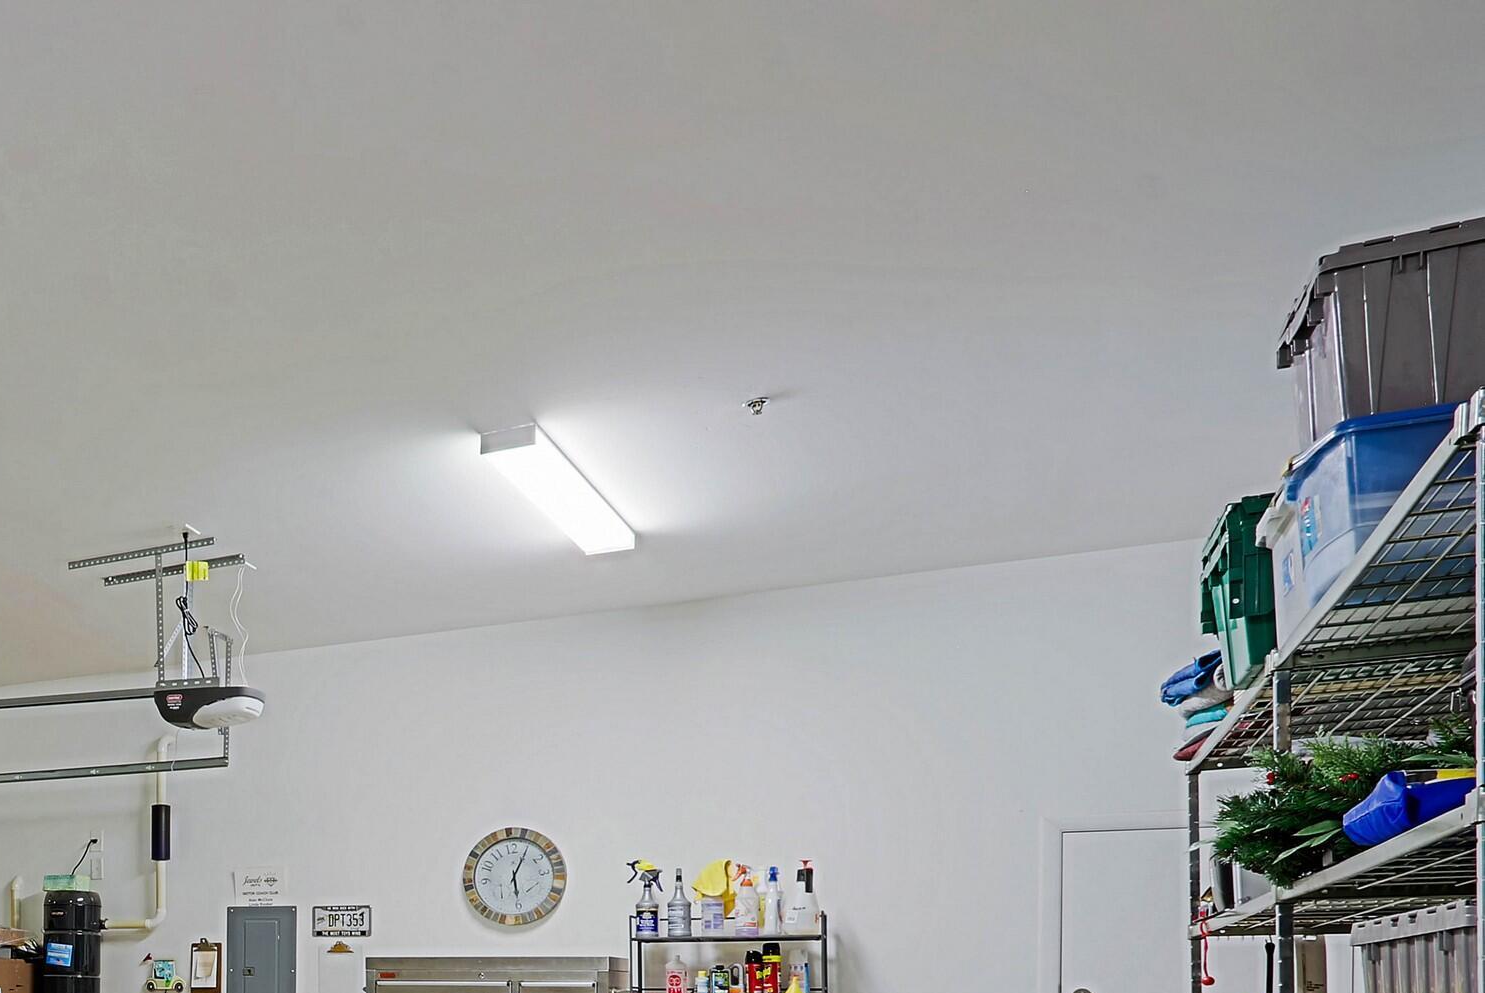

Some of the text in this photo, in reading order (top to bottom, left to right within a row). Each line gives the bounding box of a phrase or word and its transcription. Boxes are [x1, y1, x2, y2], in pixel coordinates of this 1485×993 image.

[492, 849, 503, 861] 11
[506, 843, 519, 855] 12
[533, 853, 544, 864] 2
[481, 861, 493, 873] 10
[539, 868, 550, 876] 3
[481, 877, 491, 885] 9
[515, 899, 523, 911] 6
